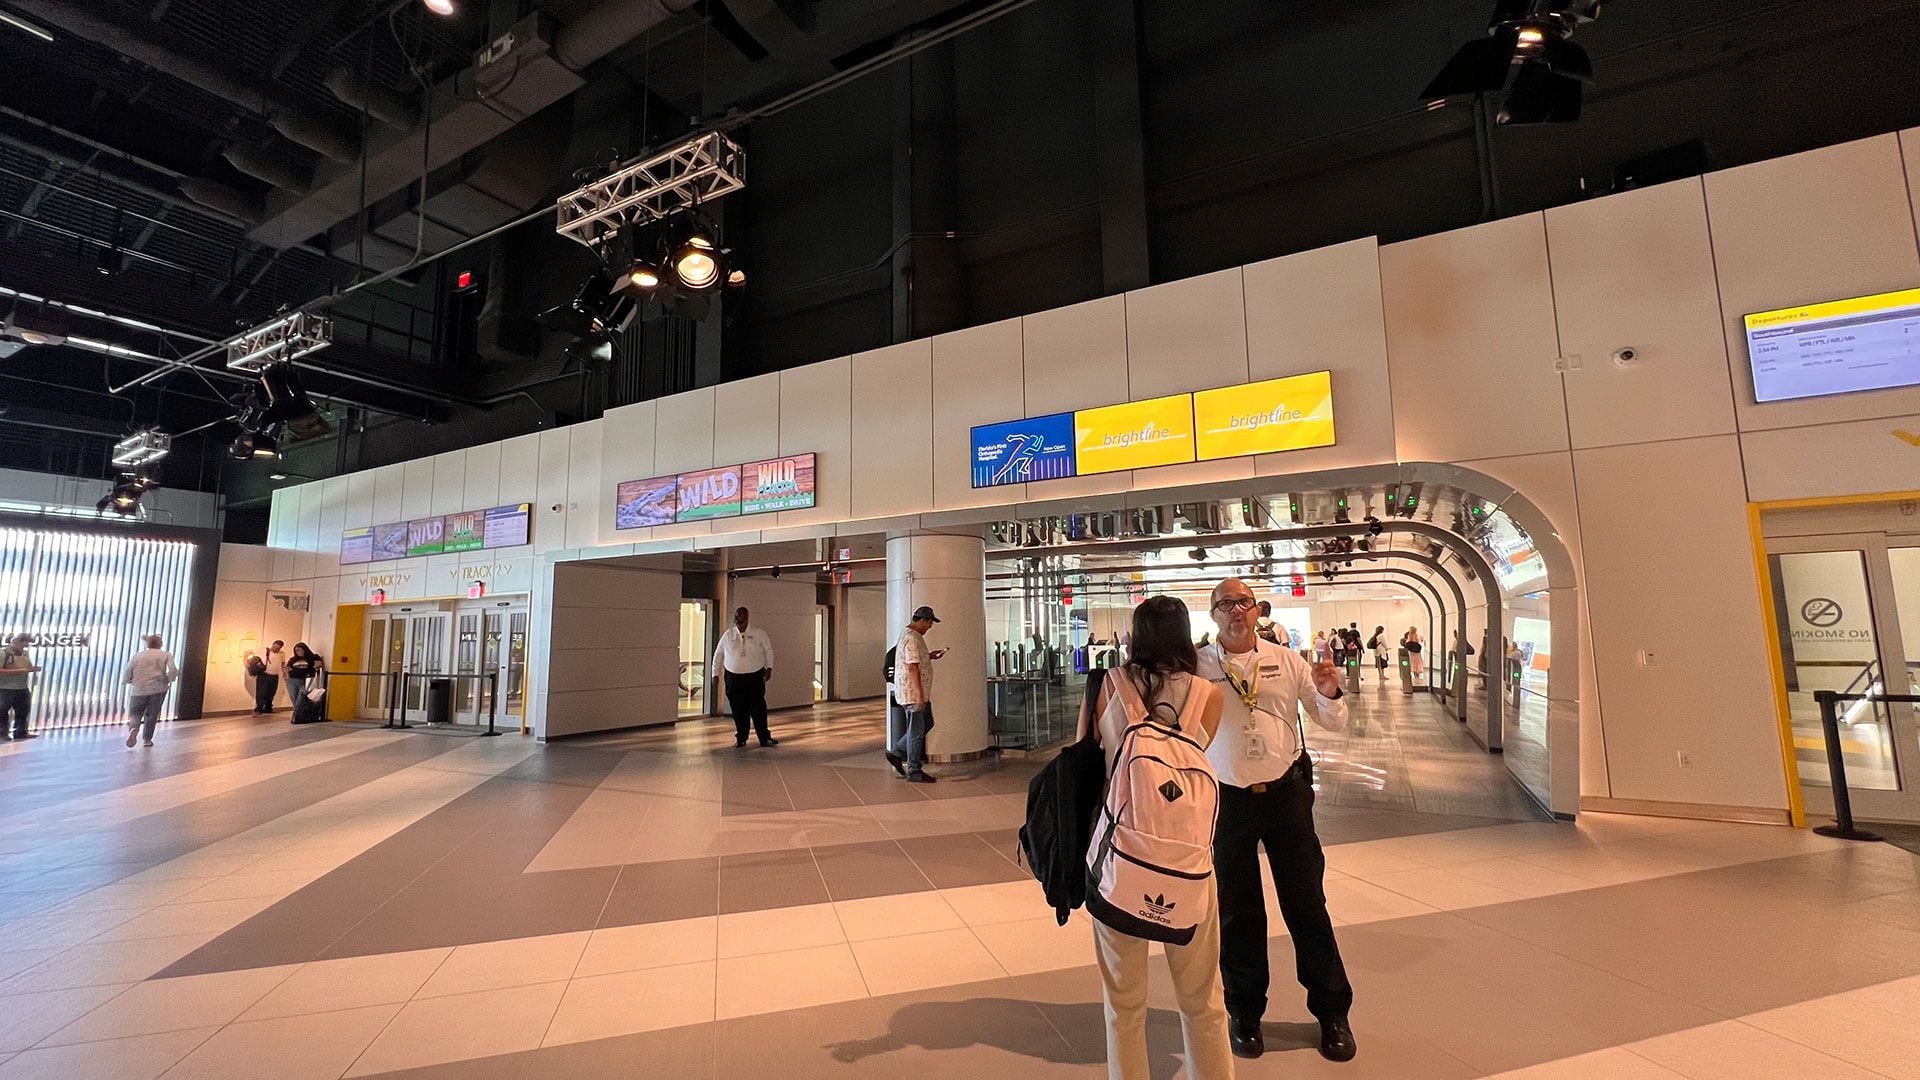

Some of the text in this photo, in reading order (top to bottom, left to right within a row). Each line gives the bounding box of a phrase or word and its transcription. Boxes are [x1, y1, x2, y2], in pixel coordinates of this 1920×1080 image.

[1752, 313, 1797, 325] Departures
[1753, 328, 1794, 339] Southbound
[1230, 403, 1301, 429] brightline
[1104, 422, 1169, 447] brightline
[757, 460, 796, 486] WILD
[680, 472, 739, 512] WILD
[765, 501, 784, 510] WALK
[453, 514, 475, 532] WILD
[409, 520, 443, 548] WILD
[463, 564, 502, 579] TRACK 2
[370, 574, 402, 586] TRACK 2
[1139, 910, 1171, 924] adidas
